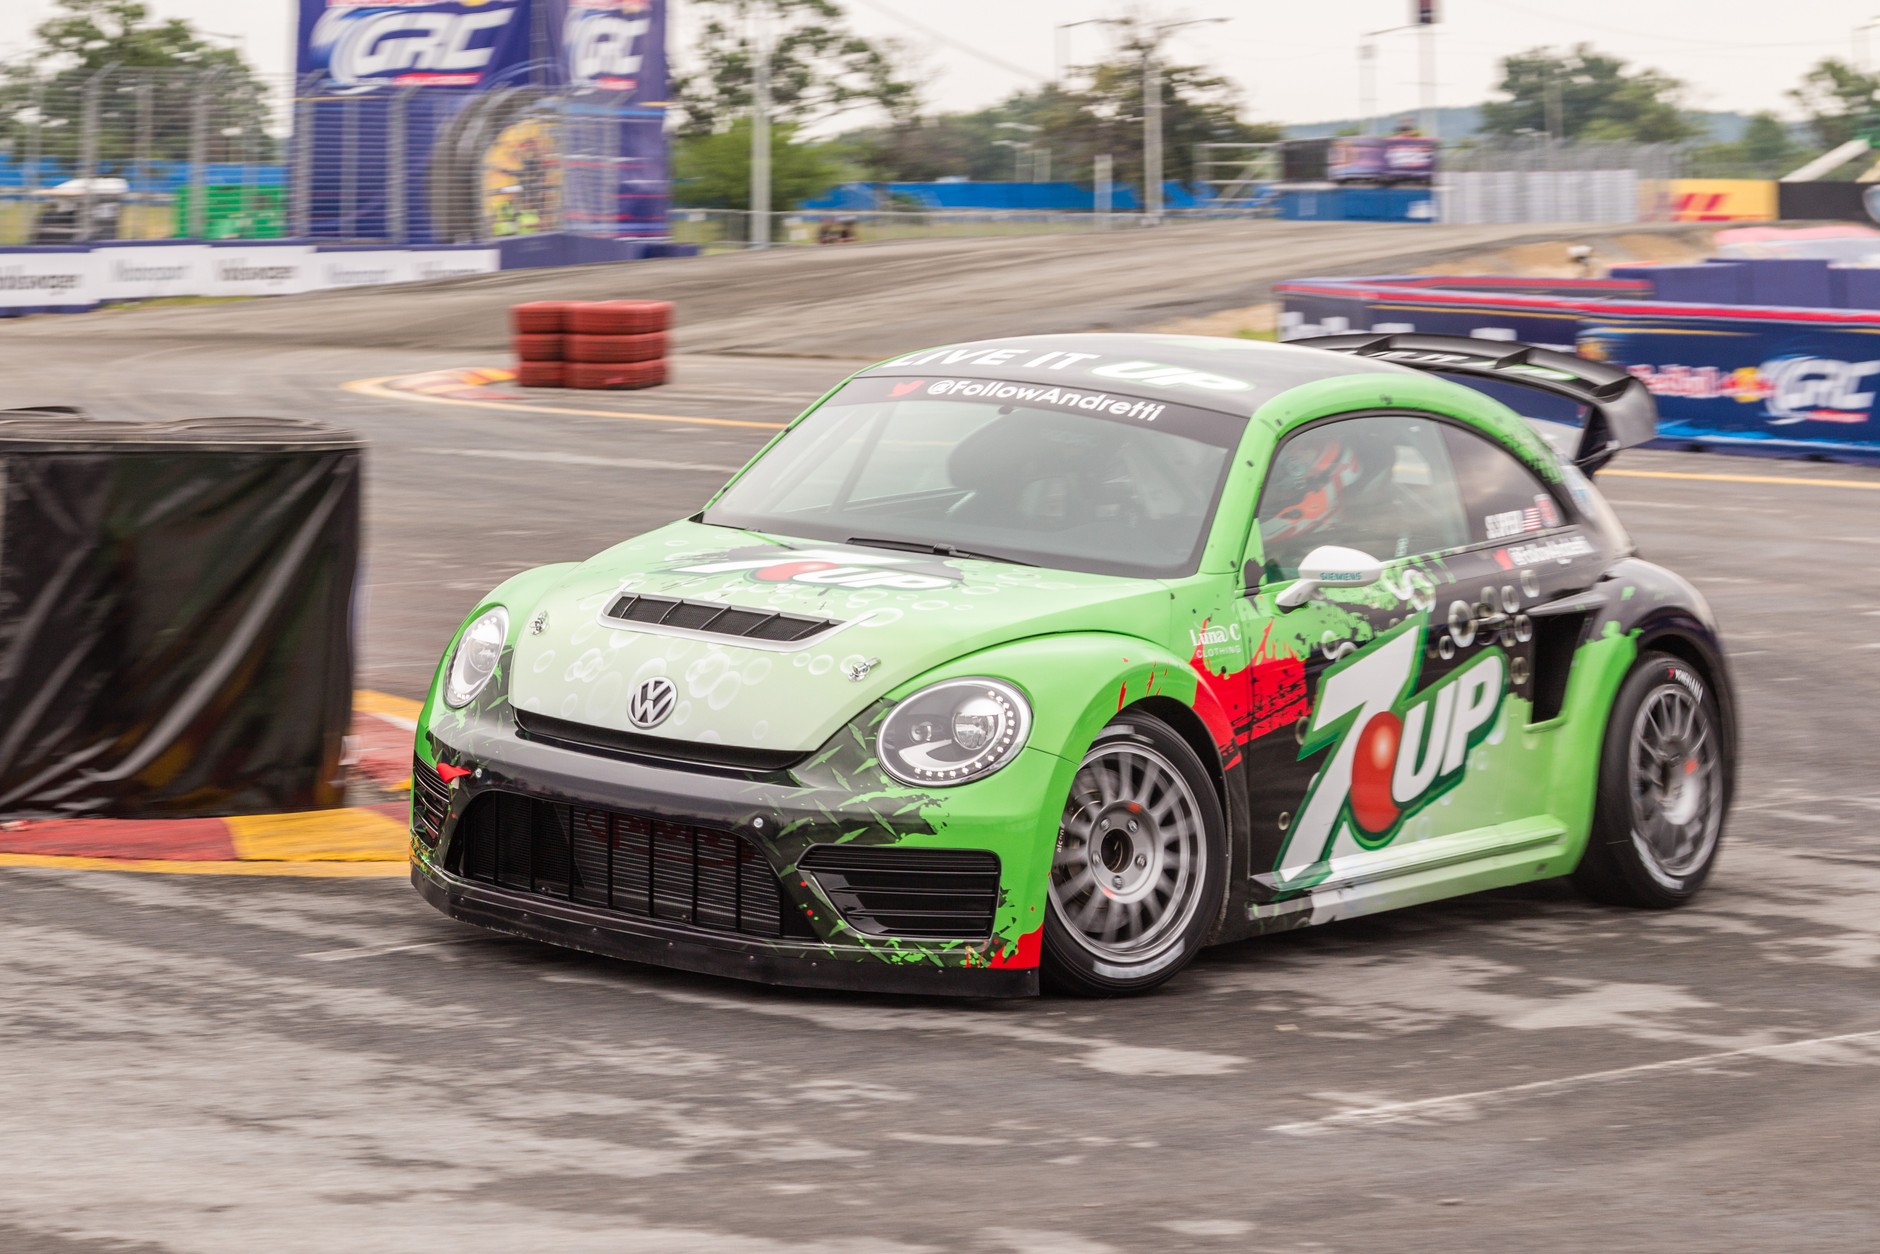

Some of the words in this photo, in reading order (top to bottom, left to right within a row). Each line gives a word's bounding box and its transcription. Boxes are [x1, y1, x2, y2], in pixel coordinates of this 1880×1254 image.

[881, 349, 1033, 368] LIVE
[1023, 351, 1101, 370] IT
[1090, 362, 1253, 391] UP
[927, 380, 1166, 421] @FollowAndretti
[1320, 572, 1361, 581] SIEMENS
